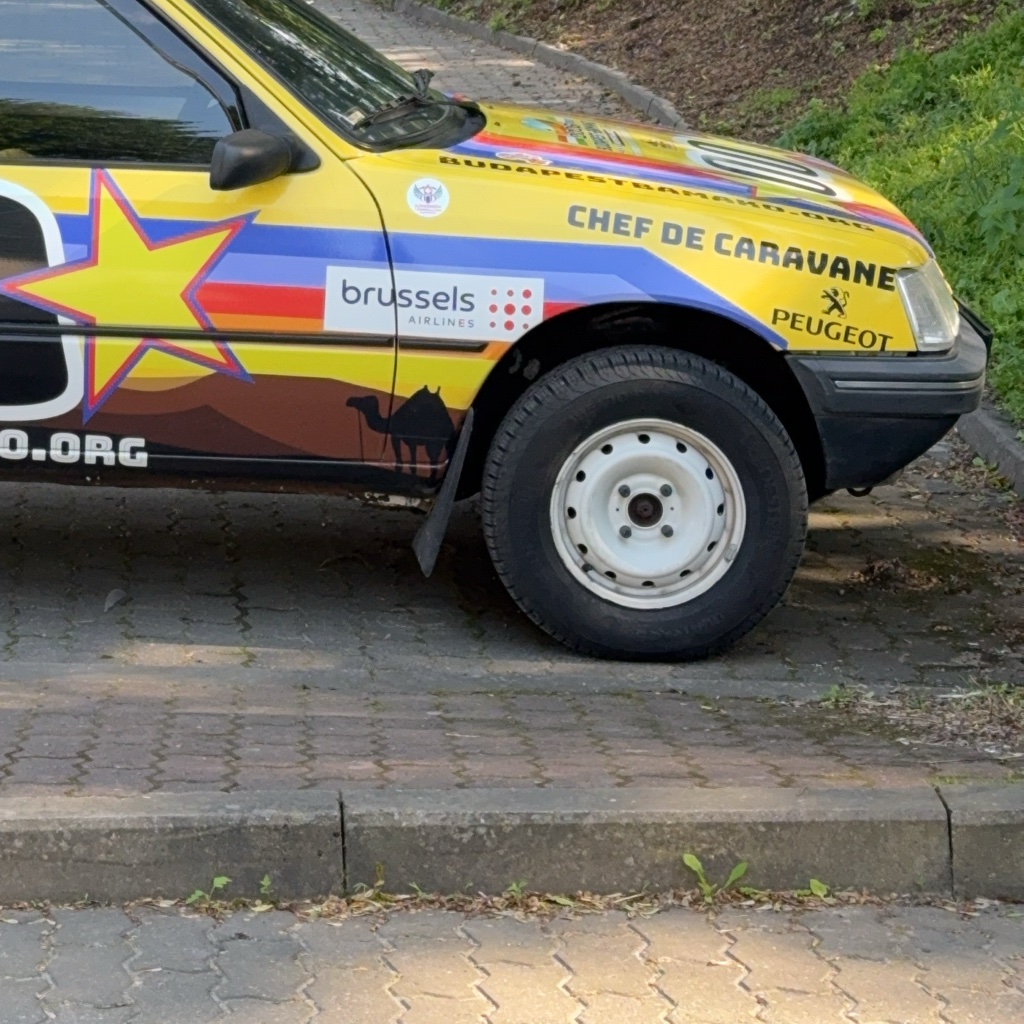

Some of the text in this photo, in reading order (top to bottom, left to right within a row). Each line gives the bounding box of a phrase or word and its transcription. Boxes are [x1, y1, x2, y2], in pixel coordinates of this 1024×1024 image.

[567, 204, 899, 292] CHEF DE CARAVANE
[342, 279, 475, 312] brussels
[408, 315, 475, 328] AIRLINES
[771, 308, 893, 352] PEUGEOT
